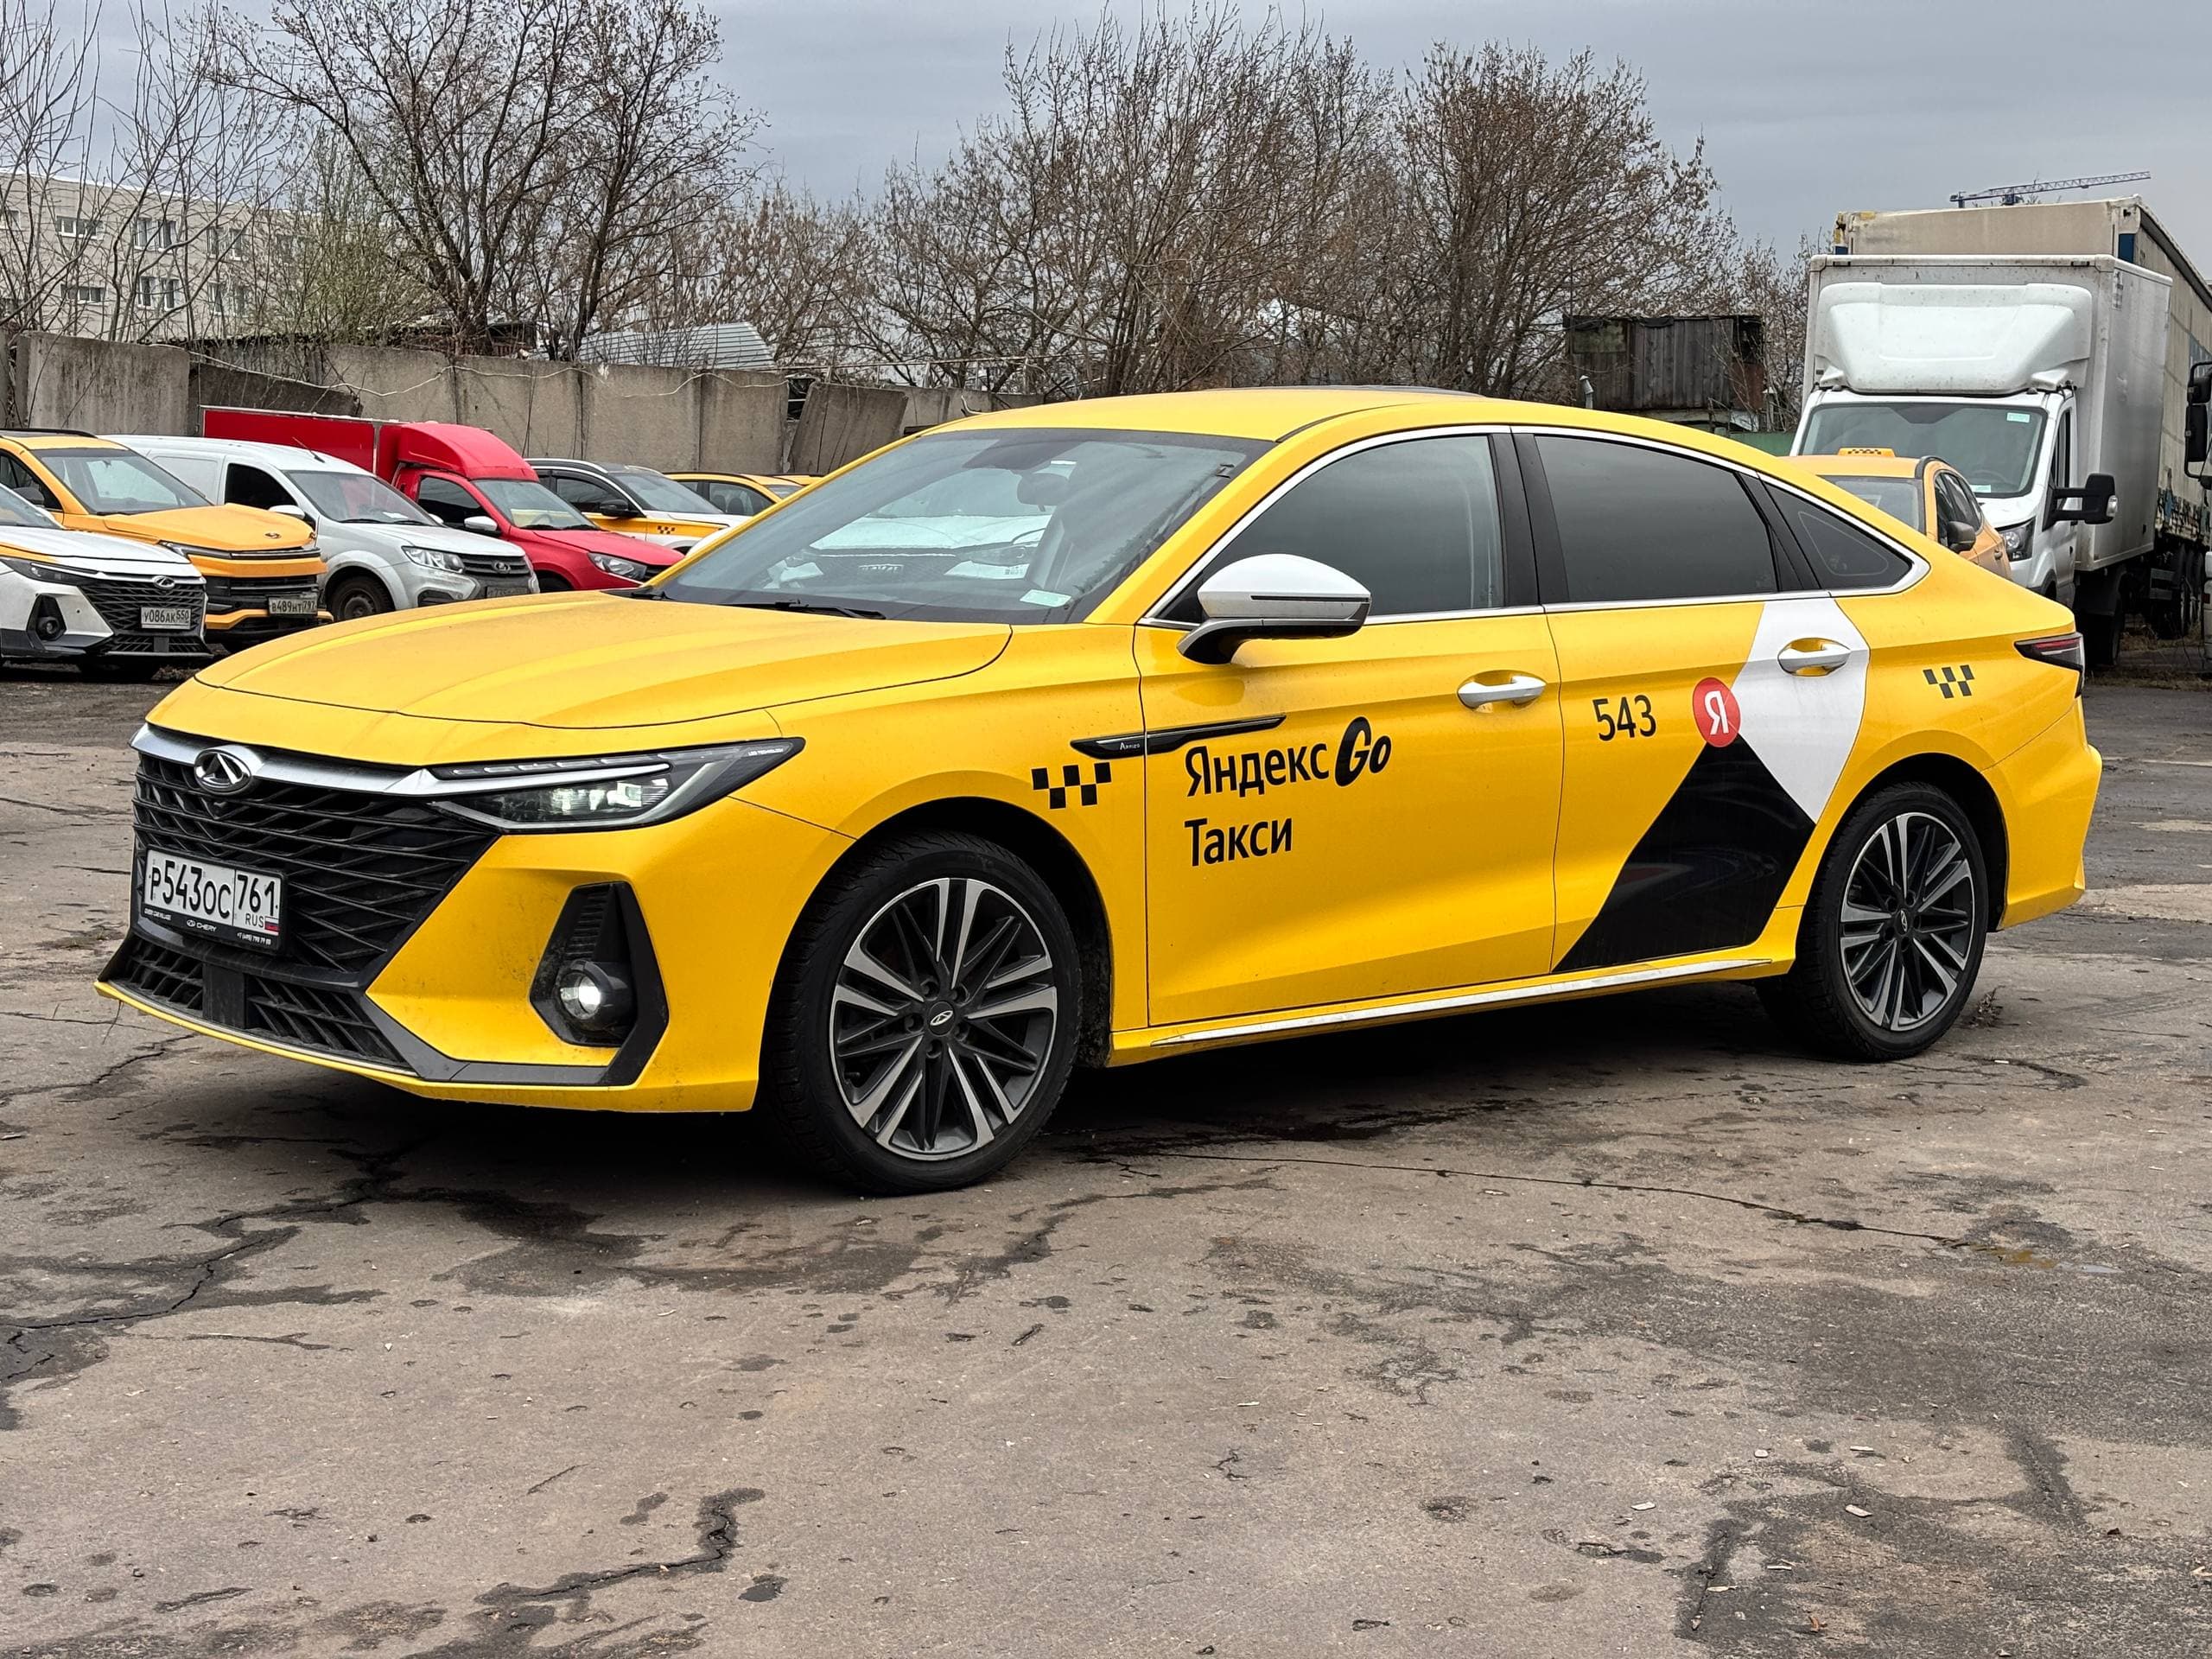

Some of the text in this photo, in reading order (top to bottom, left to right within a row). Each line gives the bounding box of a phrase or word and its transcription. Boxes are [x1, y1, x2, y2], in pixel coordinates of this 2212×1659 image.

[1592, 694, 1656, 741] 543
[1703, 690, 1729, 735] Я
[1184, 716, 1392, 798] Яндекс Go
[1184, 817, 1293, 867] Такси
[237, 874, 276, 917] 761
[245, 912, 264, 929] RUS
